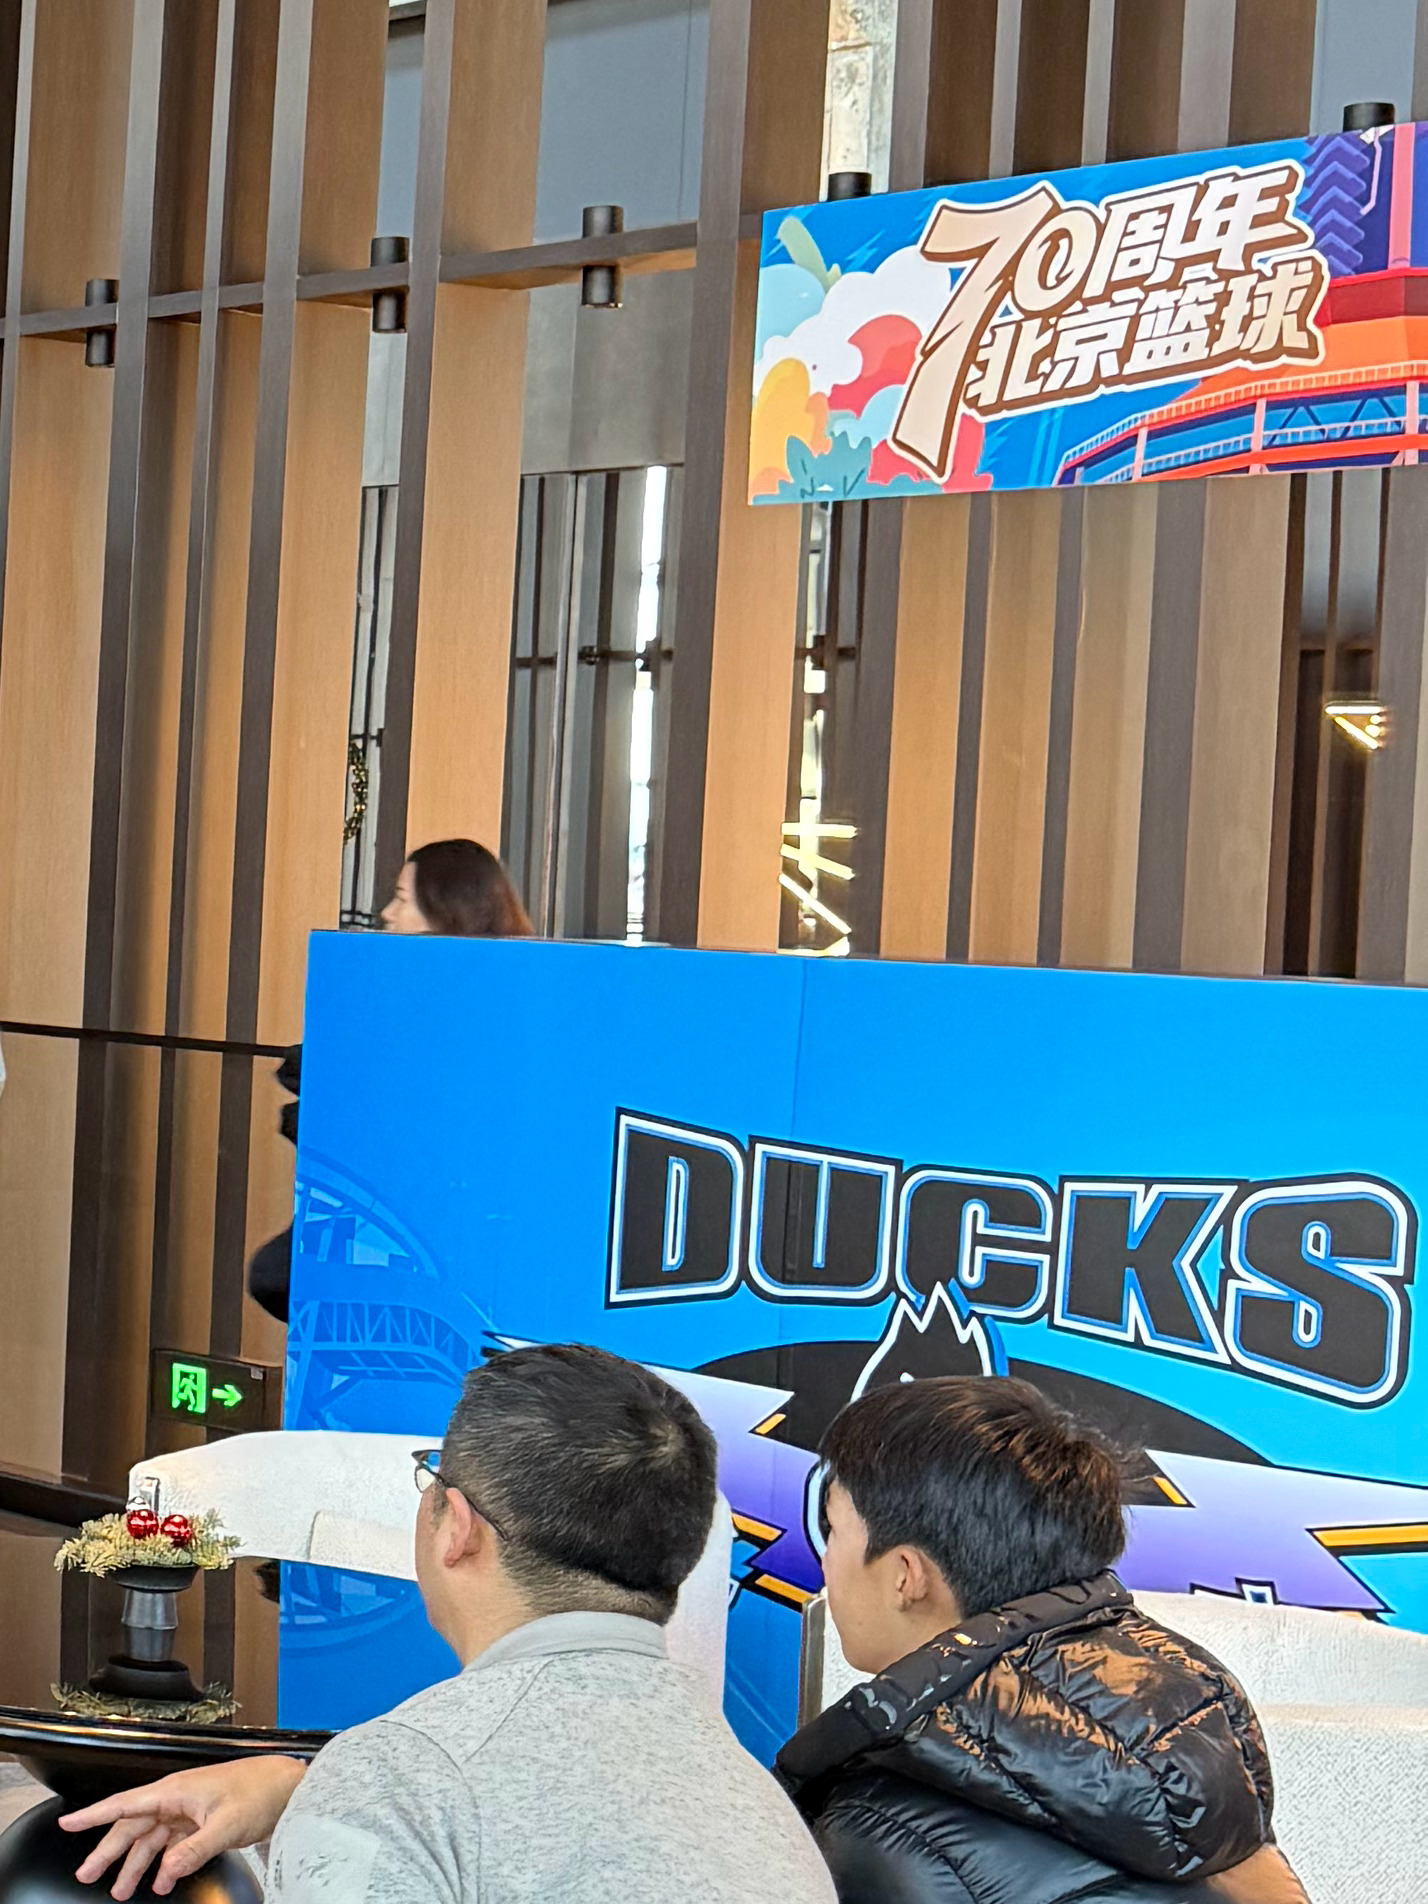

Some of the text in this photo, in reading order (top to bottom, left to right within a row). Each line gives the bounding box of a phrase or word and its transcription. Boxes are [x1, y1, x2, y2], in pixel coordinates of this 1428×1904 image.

[965, 261, 1319, 408] 北京篮球
[605, 1107, 1417, 1408] DUCKS
